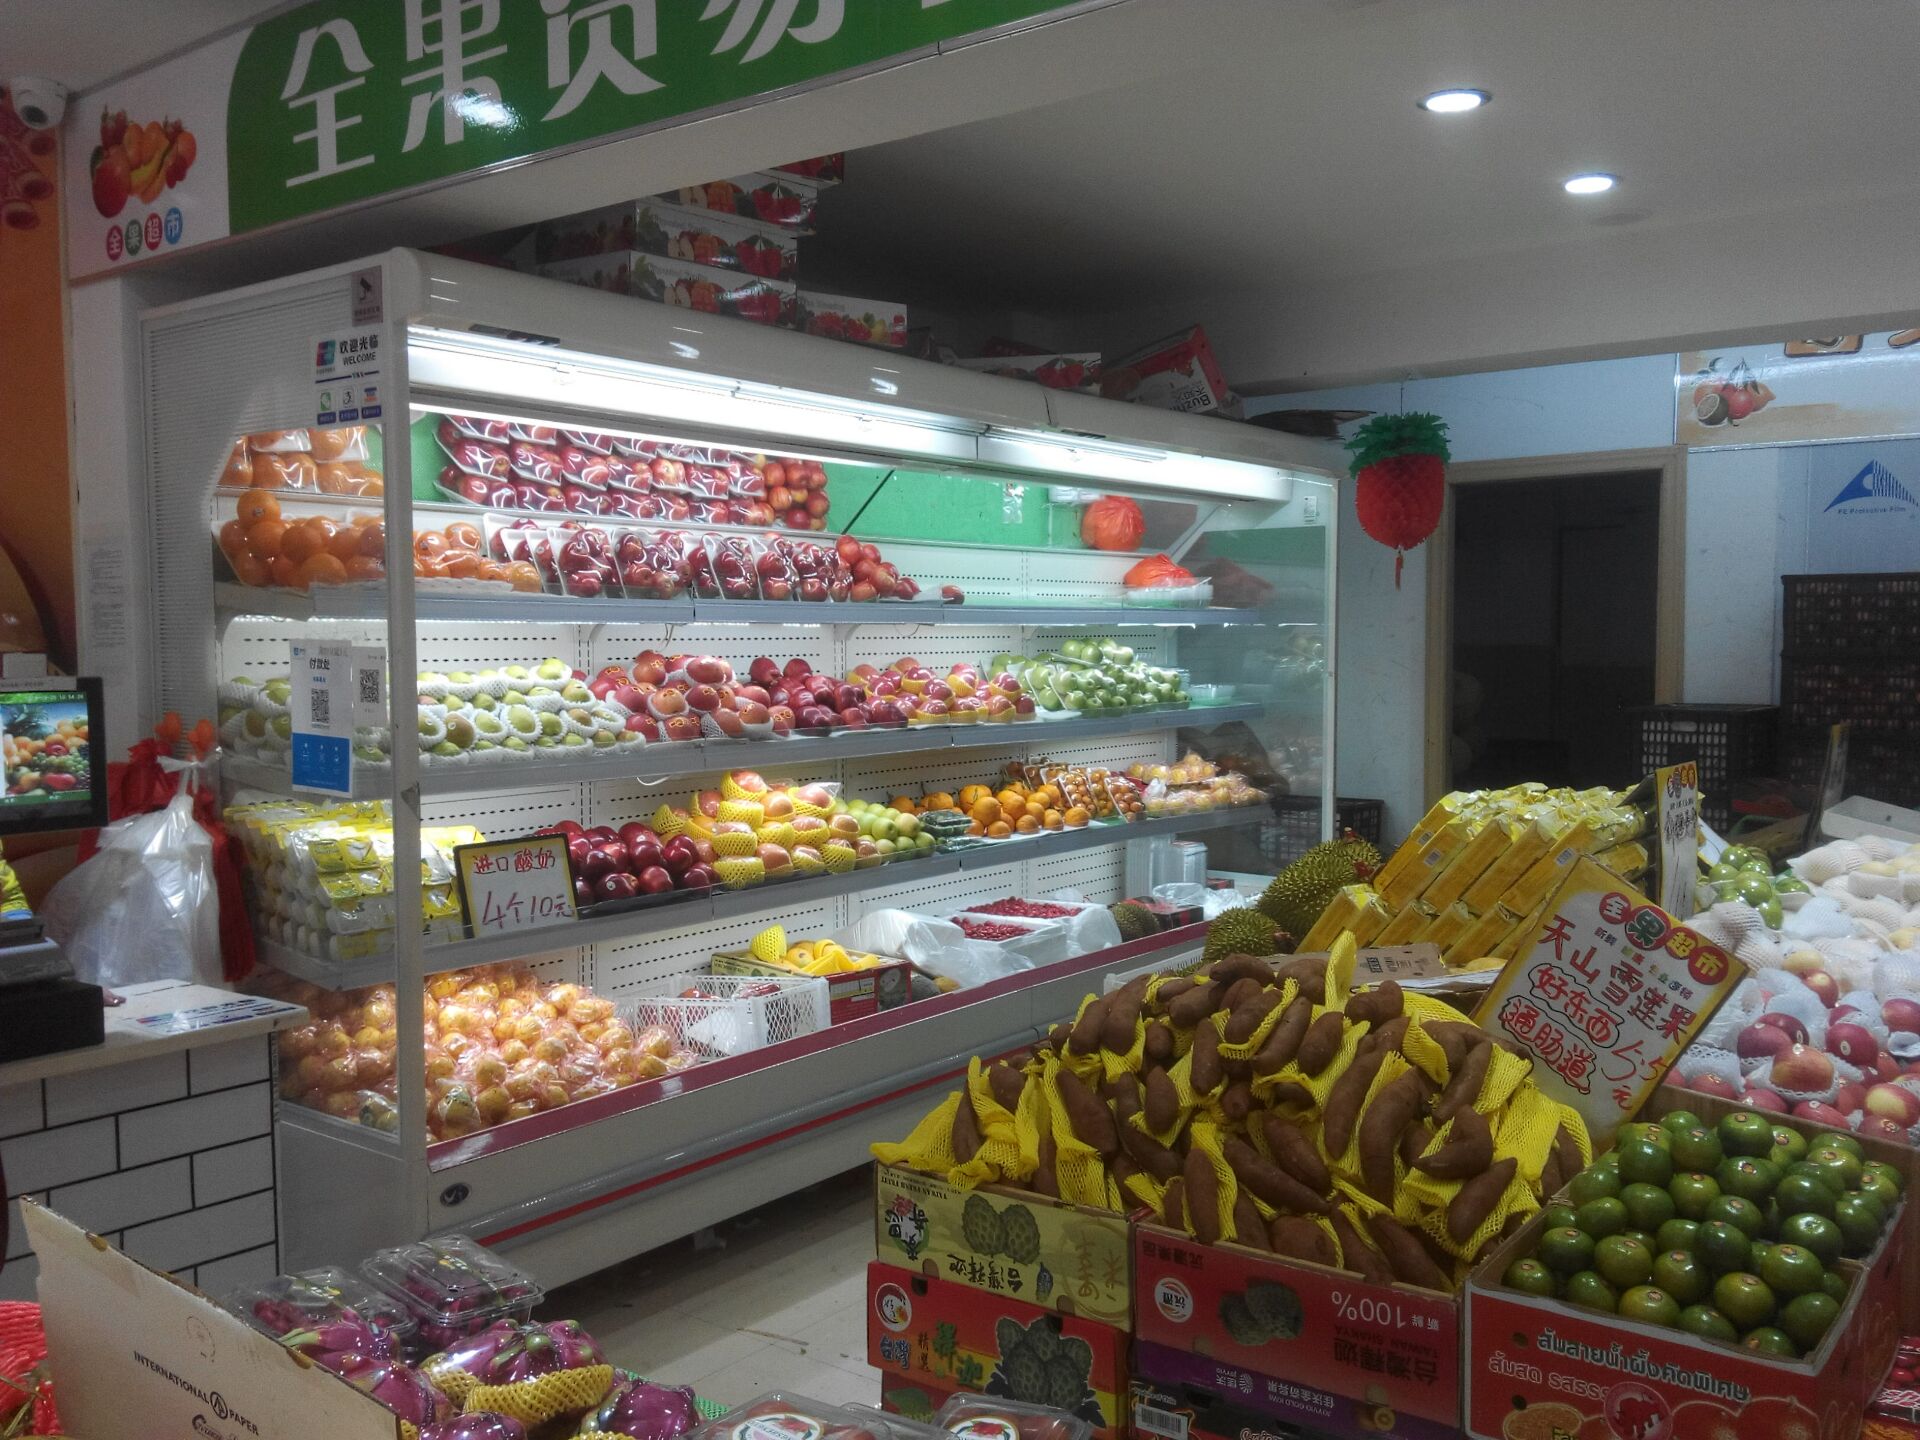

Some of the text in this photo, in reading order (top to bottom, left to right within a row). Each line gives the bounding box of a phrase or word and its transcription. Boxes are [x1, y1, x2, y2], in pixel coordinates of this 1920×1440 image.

[106, 208, 183, 260] 全果超市
[339, 334, 379, 354] 欢迎光临
[343, 352, 376, 366] WELCOME
[309, 657, 331, 671] 付款处
[473, 847, 556, 875] 进口酸奶
[1600, 893, 1728, 984] 全果超市
[1535, 965, 1619, 1044] 好东西
[1498, 996, 1592, 1092] 通肠道
[1611, 1084, 1633, 1111] 元
[1331, 1290, 1407, 1329] 100%
[1334, 1323, 1439, 1359] TAIWAN SHAKYA
[133, 1350, 211, 1405] INTERNATIONAL
[228, 1408, 260, 1436] PAPER
[1266, 1379, 1336, 1409] 佳沃金奇异果
